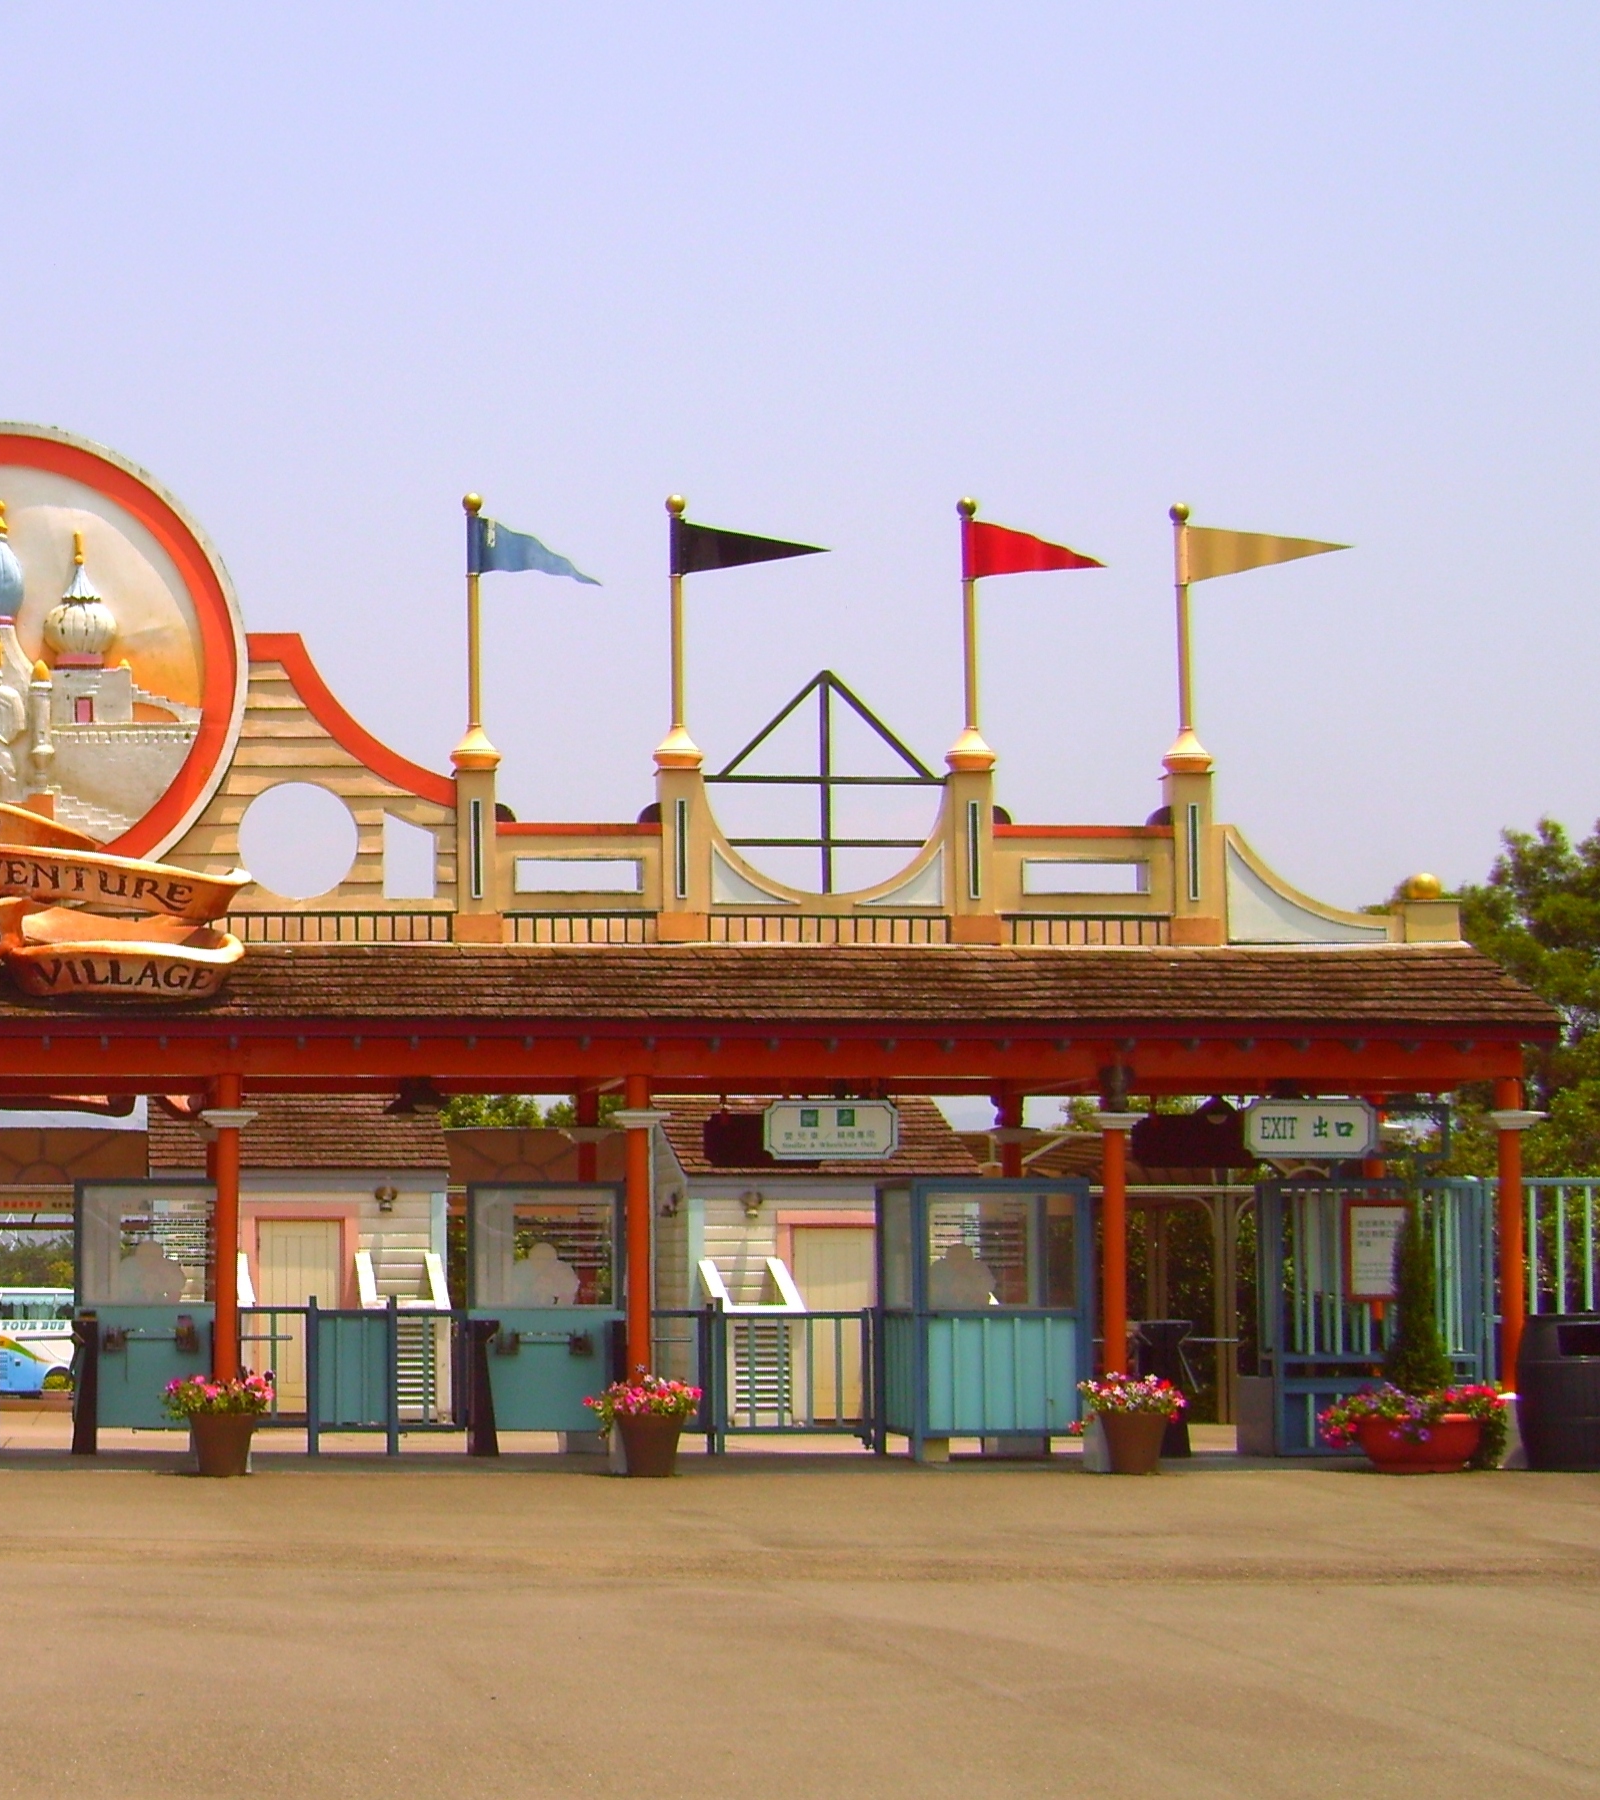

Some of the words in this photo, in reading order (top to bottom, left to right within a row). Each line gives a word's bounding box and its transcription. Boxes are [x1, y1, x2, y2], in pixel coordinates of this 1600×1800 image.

[33, 957, 215, 990] VILLAGE
[1260, 1116, 1298, 1139] EXIT
[1313, 1115, 1354, 1138] 出口
[2, 1321, 38, 1331] TOUR
[41, 1321, 66, 1330] BUS
